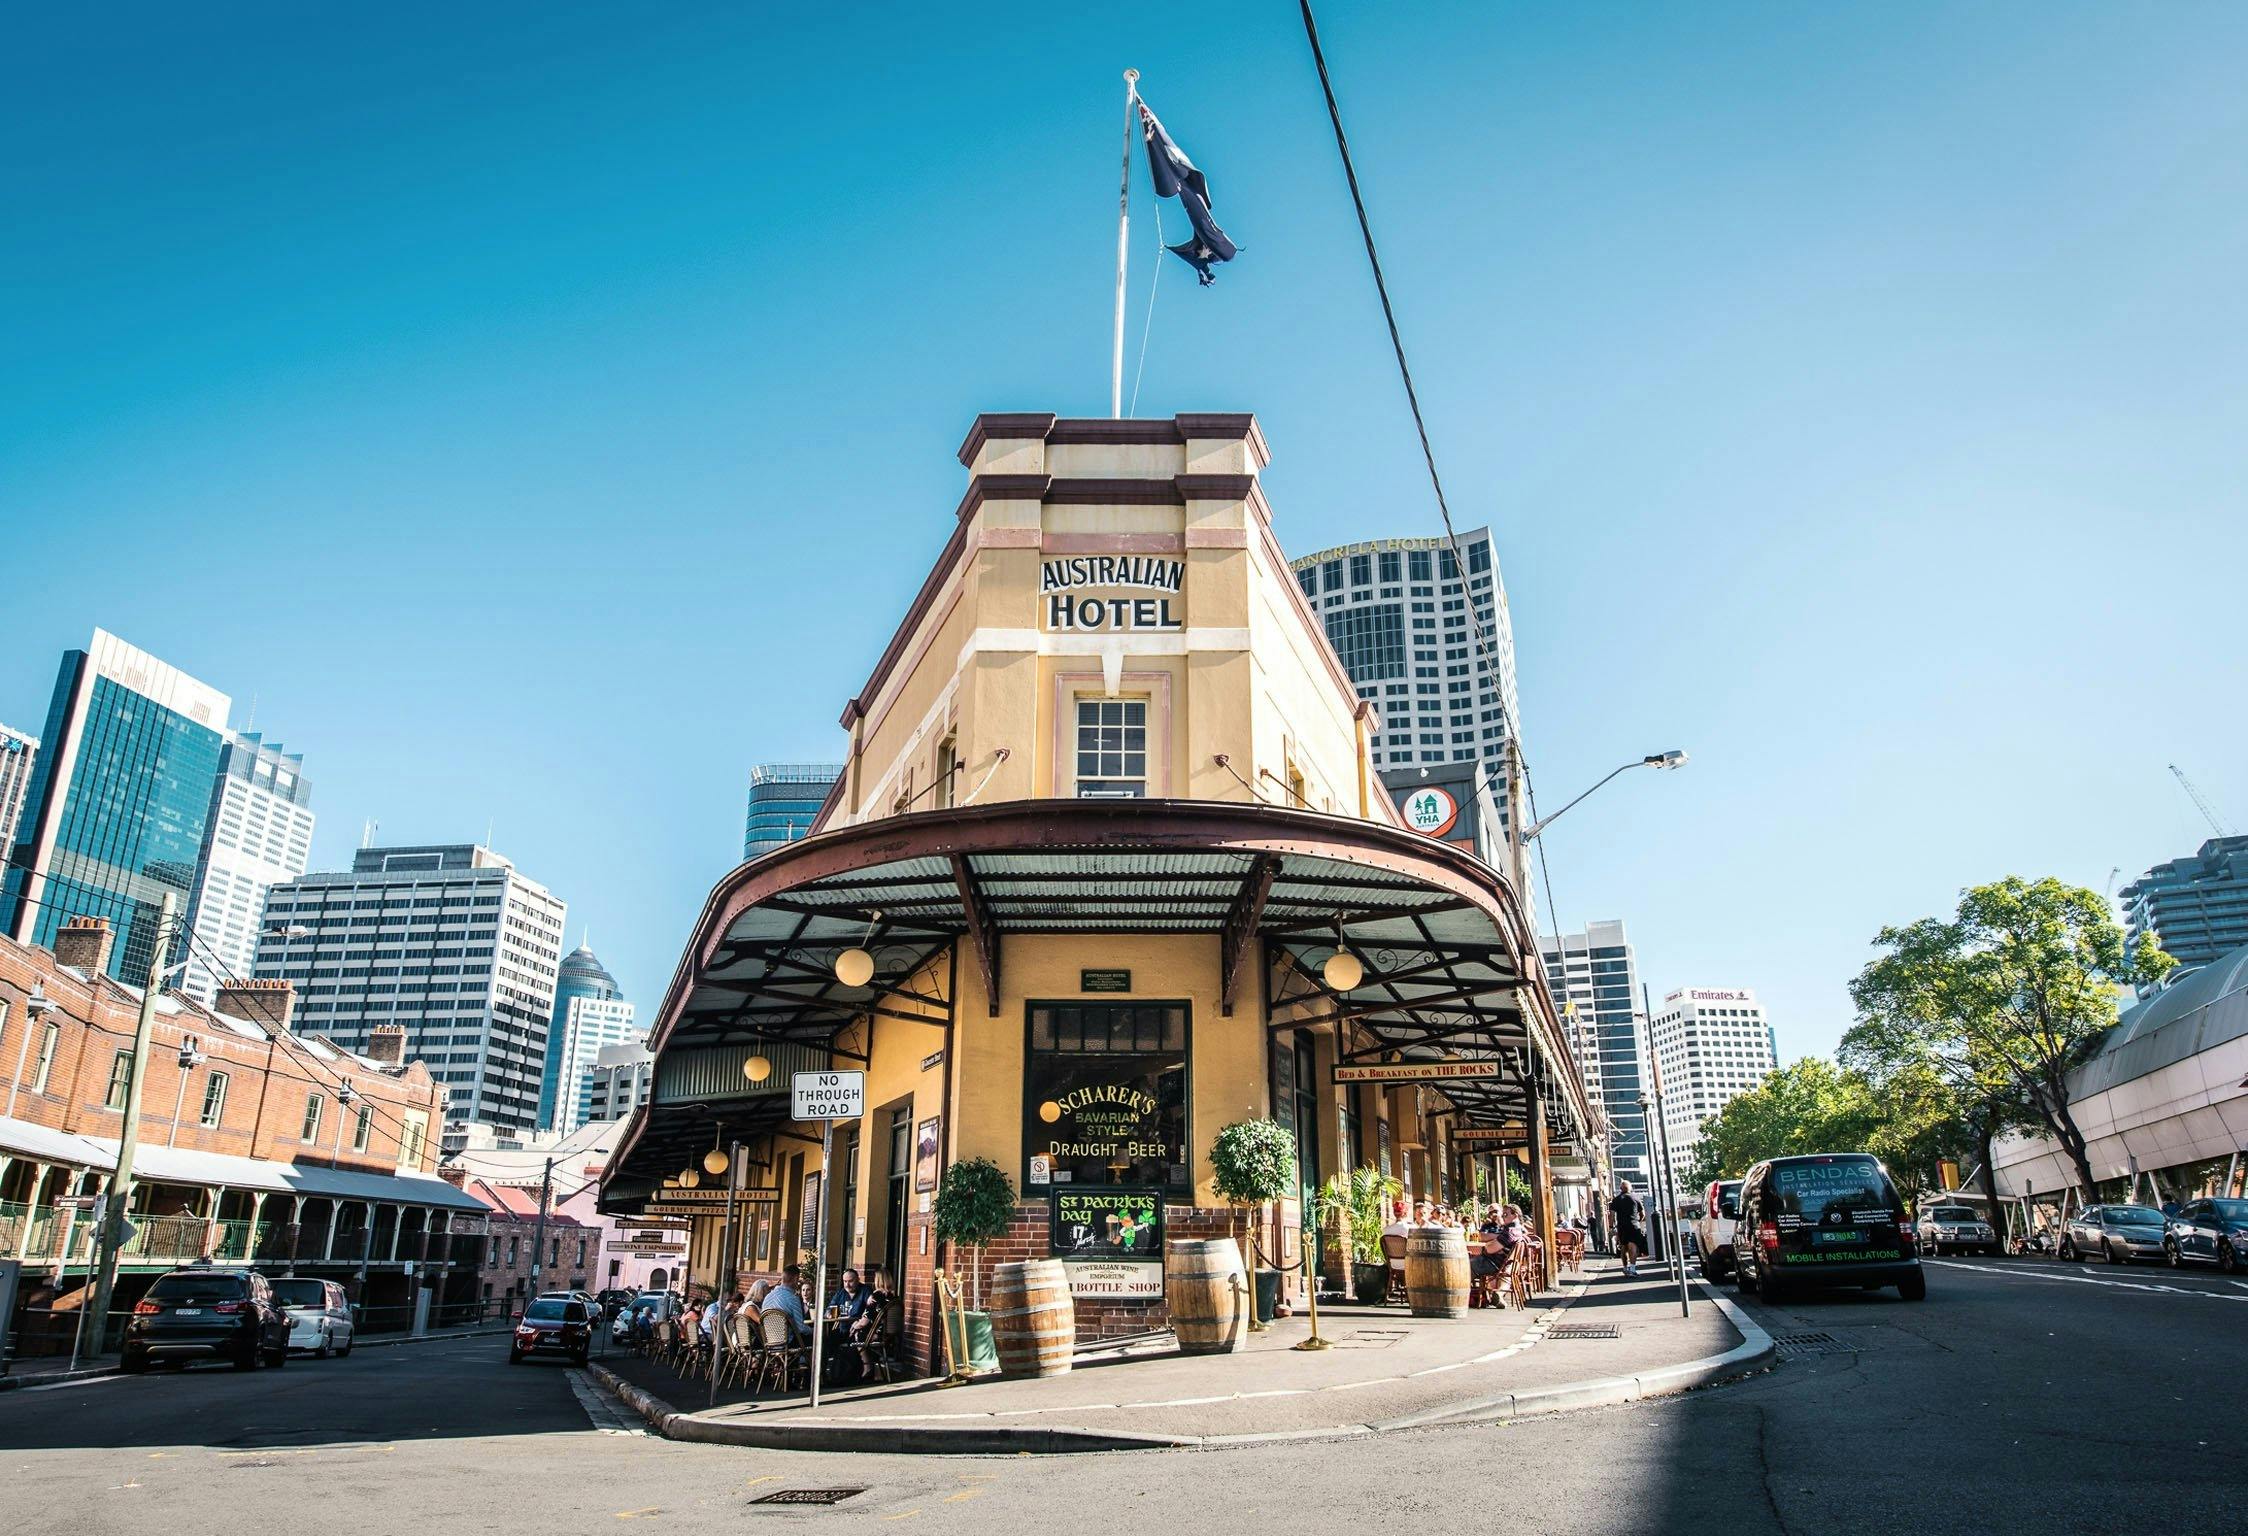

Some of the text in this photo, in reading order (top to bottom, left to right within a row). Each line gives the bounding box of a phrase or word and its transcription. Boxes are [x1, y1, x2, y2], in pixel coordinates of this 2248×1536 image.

[1387, 537, 1449, 551] HOTEL
[1040, 556, 1185, 595] AUSTRALIAN
[1047, 594, 1182, 632] HOTEL
[1415, 815, 1440, 824] YHA
[1690, 989, 1735, 1001] Emirates
[1338, 1070, 1355, 1079] BED
[1357, 1070, 1366, 1078] &
[1369, 1068, 1418, 1078] BREAKFAST
[1435, 1065, 1457, 1076] THE
[1459, 1064, 1494, 1075] ROCKS
[819, 1075, 839, 1086] NO
[798, 1088, 860, 1101] THROUGH
[1058, 1085, 1157, 1115] SCHARER'S
[808, 1104, 849, 1115] ROAD
[1075, 1112, 1140, 1123] BAVARIAN
[1087, 1125, 1128, 1136] STYLE
[1050, 1141, 1166, 1157] DRAUGHT BEER
[1780, 1166, 1872, 1181] BENDAS
[739, 1191, 770, 1199] HOTEL
[1797, 1190, 1809, 1198] Car
[1811, 1189, 1831, 1197] Radio
[1786, 1250, 1900, 1263] MOBILE INSTALLATIONS
[1076, 1264, 1139, 1273] AUSTRALIAN WINE
[1077, 1283, 1122, 1292] BOTTLE
[1129, 1283, 1160, 1292] SHOP
